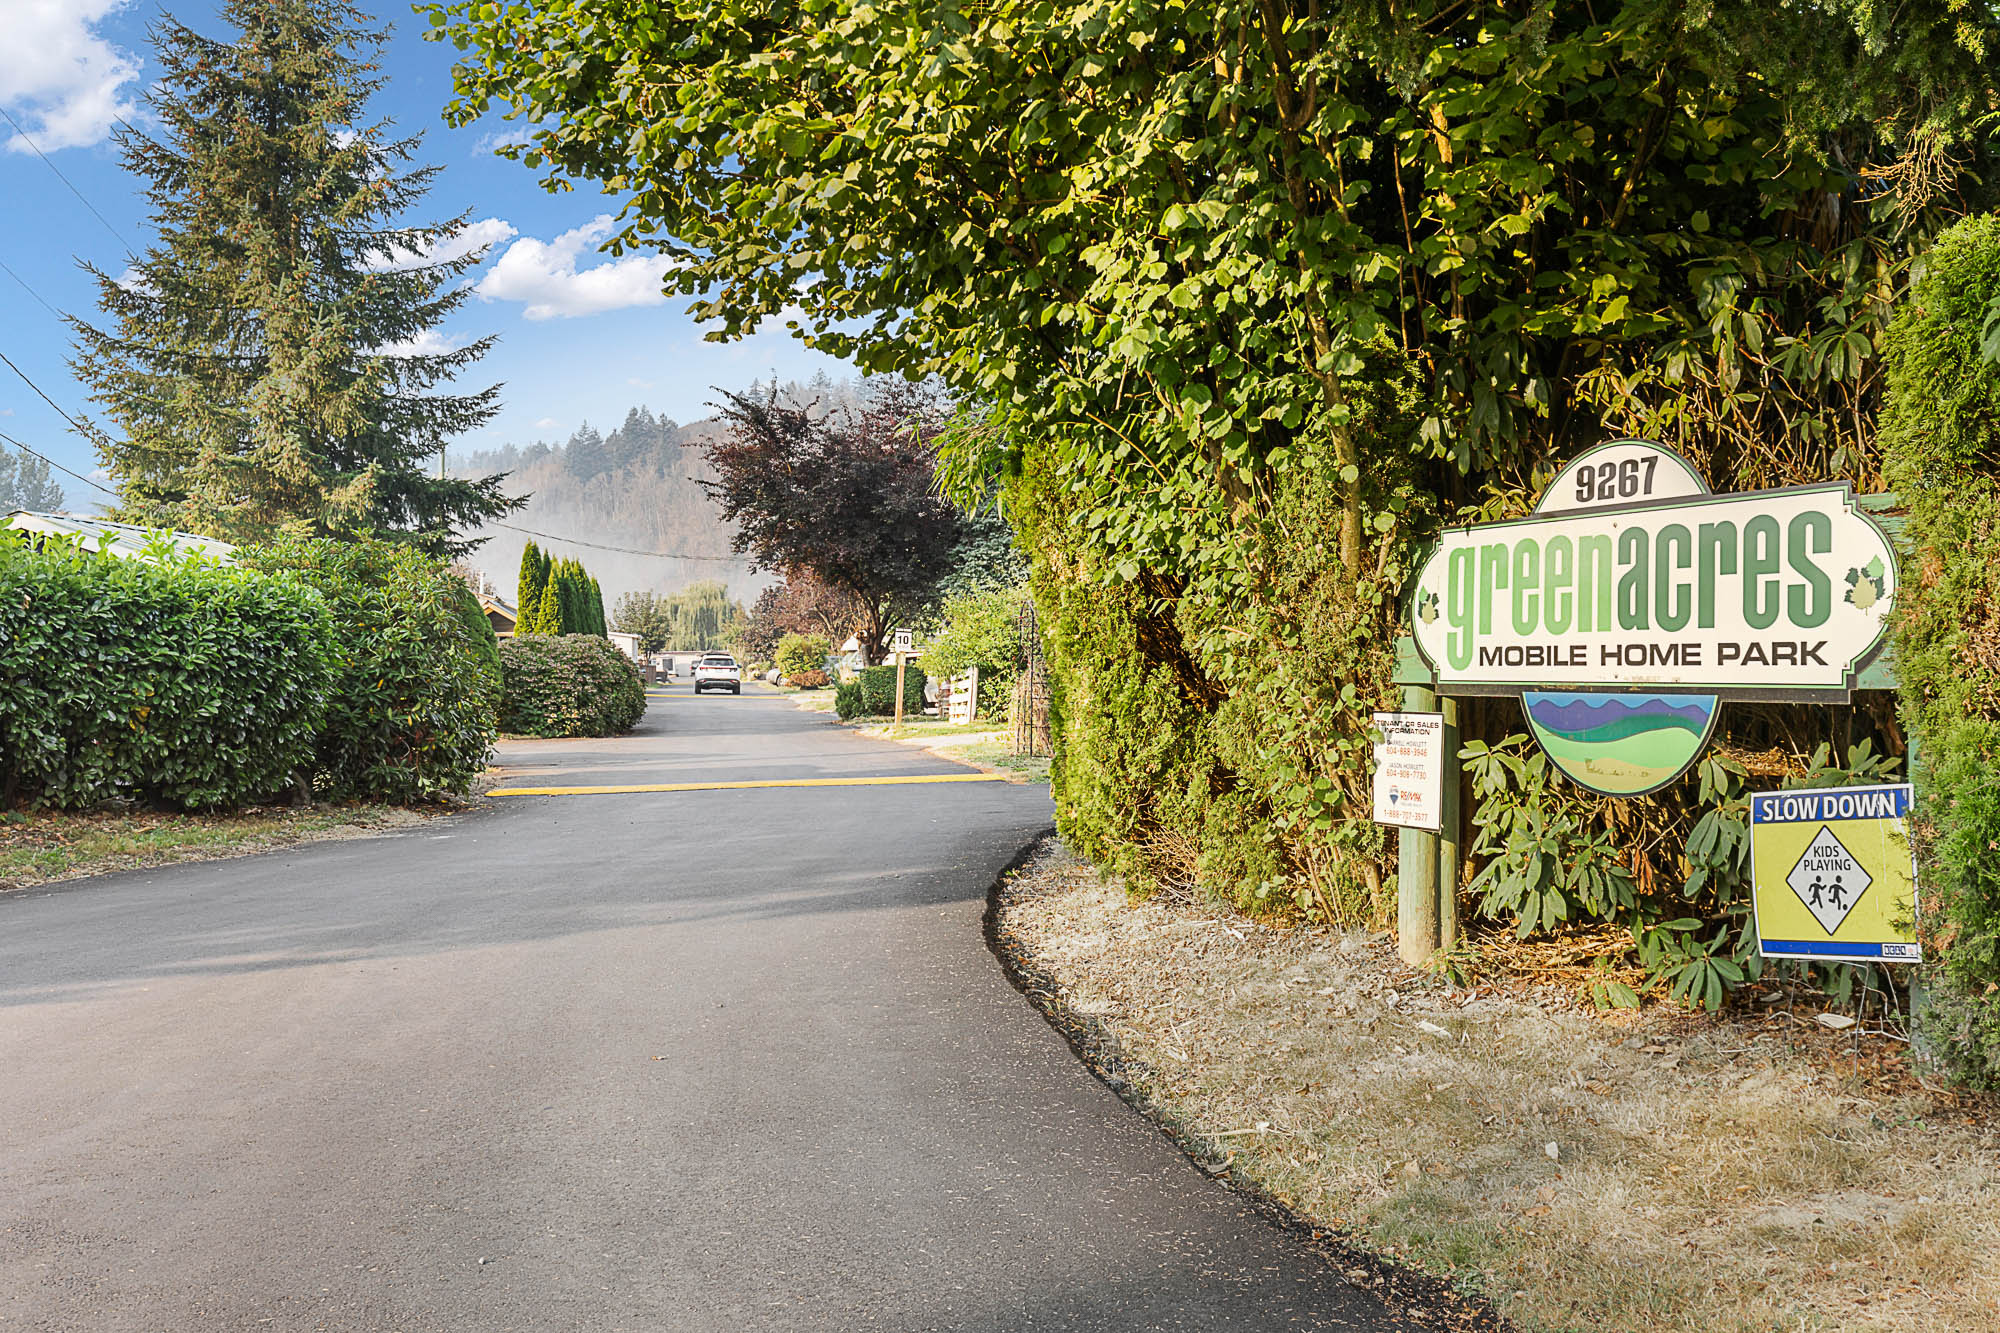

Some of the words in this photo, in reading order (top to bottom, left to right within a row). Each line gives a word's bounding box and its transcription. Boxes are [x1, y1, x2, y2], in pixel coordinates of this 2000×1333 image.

[1575, 455, 1659, 503] 9267
[1446, 510, 1832, 671] greenacres
[897, 635, 909, 645] 10
[1478, 644, 1588, 667] MOBILE
[1600, 642, 1702, 667] HOME
[1717, 640, 1829, 667] PARK
[1376, 720, 1403, 728] TENANT
[1400, 790, 1422, 802] RE/MAX
[1762, 795, 1819, 822] SLOW
[1823, 792, 1897, 819] DOWN
[1813, 845, 1839, 858] KIDS
[1803, 859, 1852, 871] PLAYING
